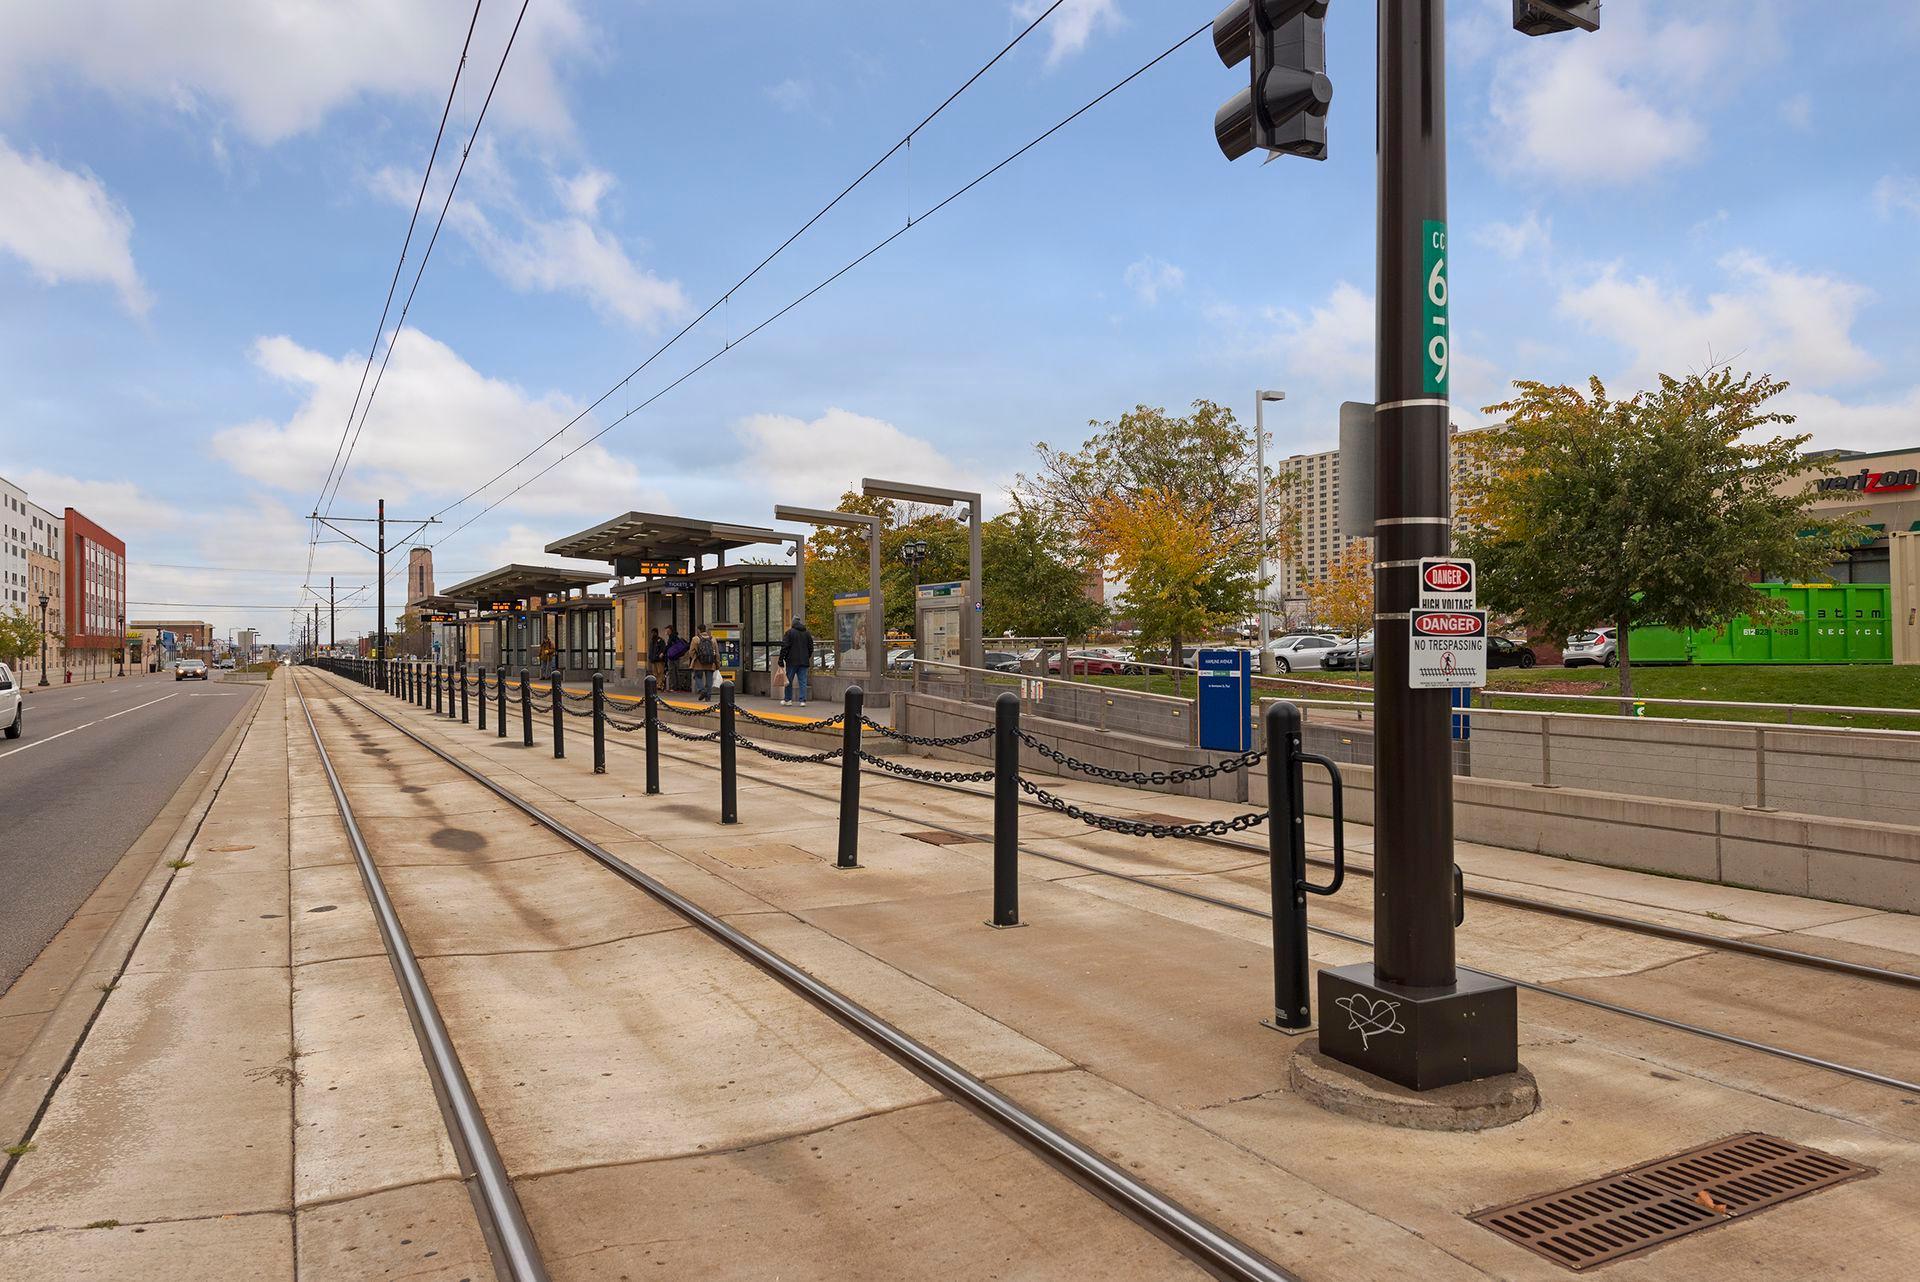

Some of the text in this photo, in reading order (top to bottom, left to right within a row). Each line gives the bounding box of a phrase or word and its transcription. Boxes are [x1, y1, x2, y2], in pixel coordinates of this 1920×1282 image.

[1817, 468, 1918, 493] verizon
[1432, 569, 1462, 585] DANGER
[1422, 599, 1473, 610] HIGH VOLTAGE
[1422, 617, 1475, 631] DANGER
[1414, 640, 1483, 651] NO TRESPASSING
